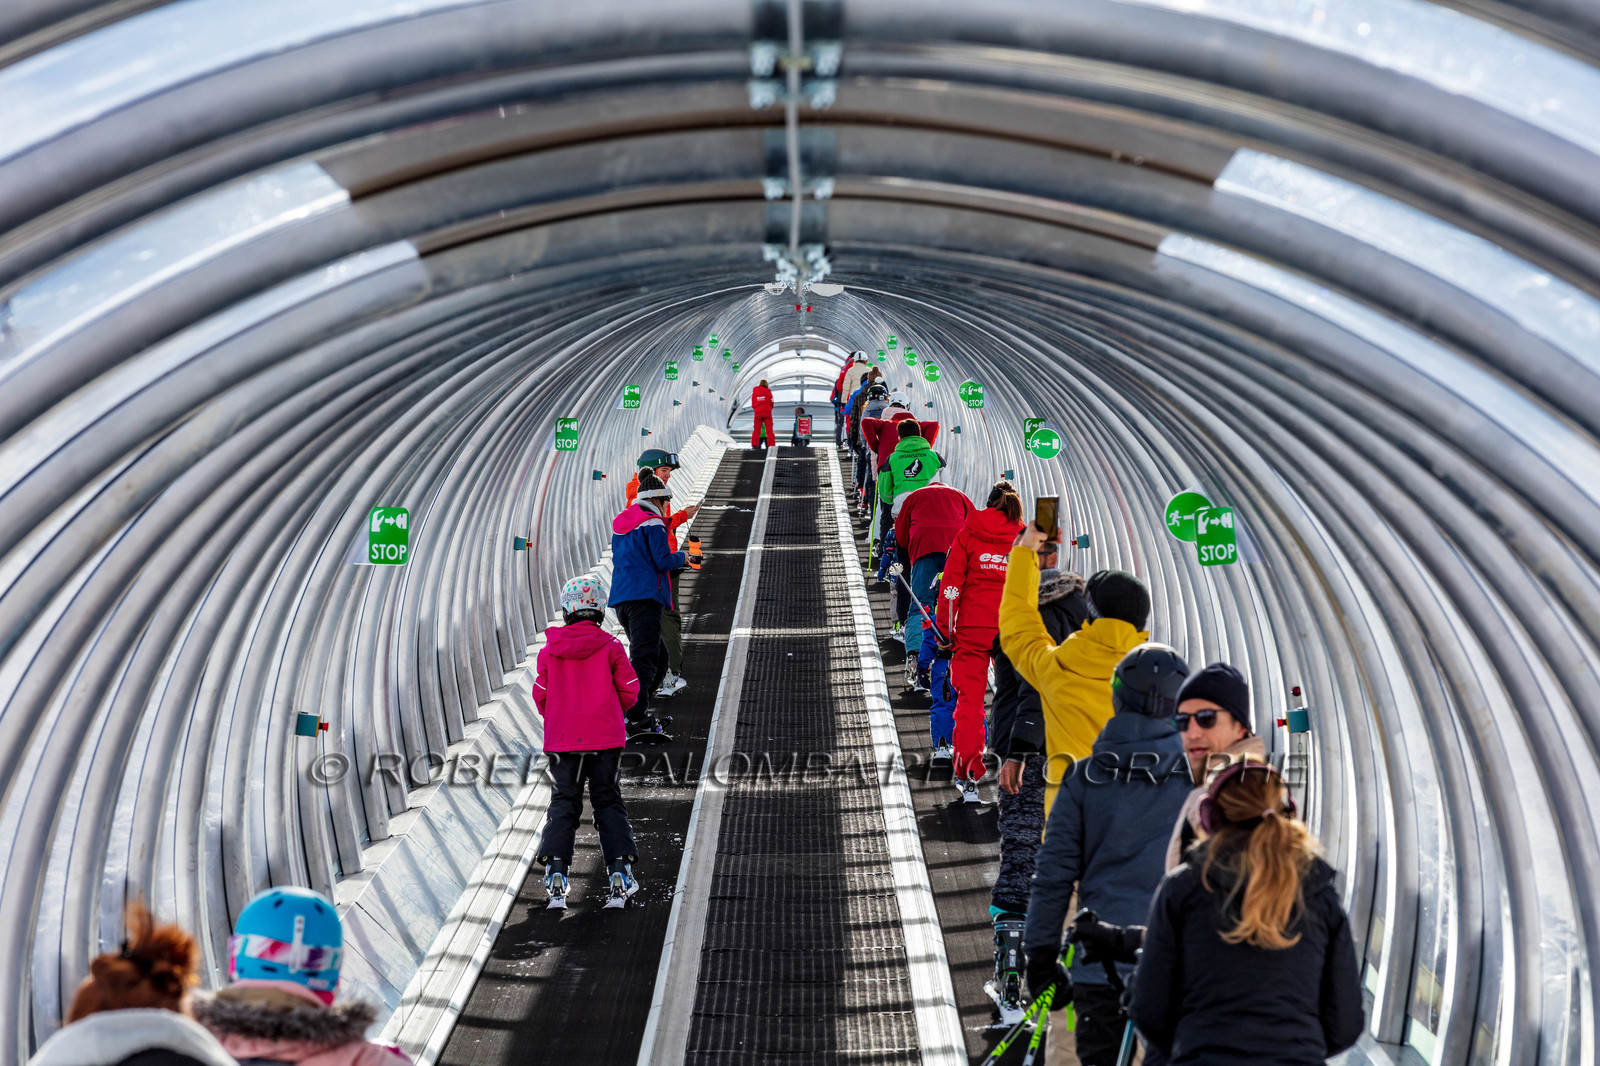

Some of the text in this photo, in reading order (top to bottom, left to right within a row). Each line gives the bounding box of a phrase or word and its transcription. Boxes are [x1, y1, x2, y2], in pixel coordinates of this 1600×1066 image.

[624, 400, 640, 408] STOP
[968, 399, 984, 407] STOP
[556, 438, 578, 449] STOP
[371, 543, 407, 560] STOP
[1200, 543, 1236, 562] STOP
